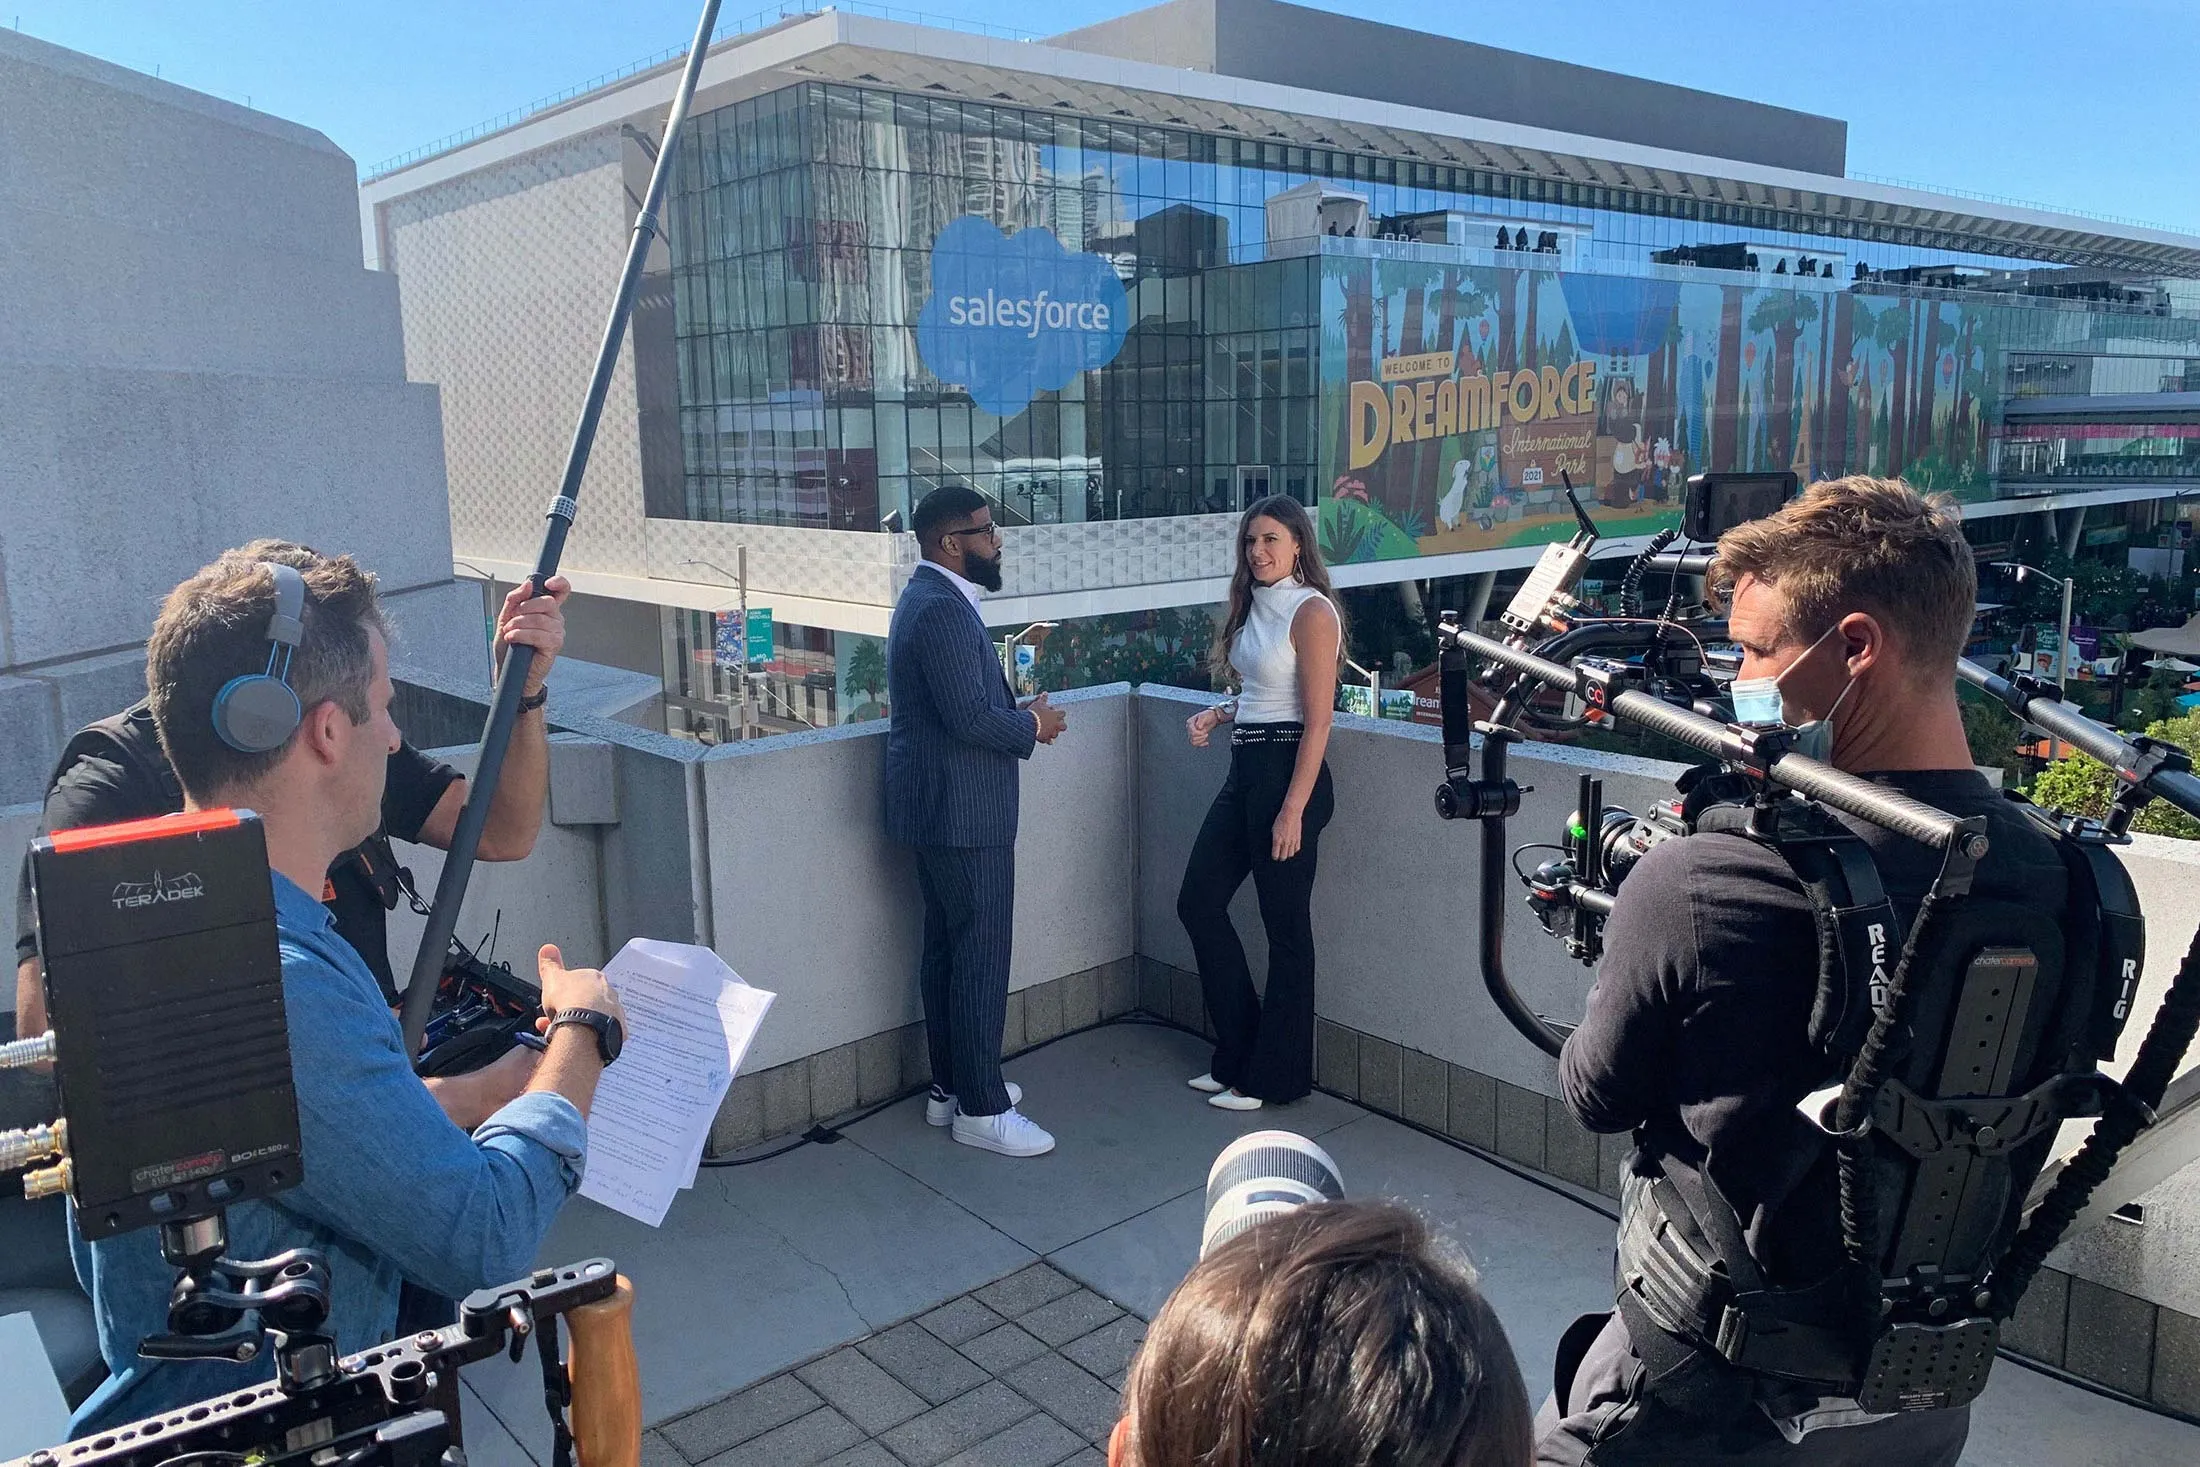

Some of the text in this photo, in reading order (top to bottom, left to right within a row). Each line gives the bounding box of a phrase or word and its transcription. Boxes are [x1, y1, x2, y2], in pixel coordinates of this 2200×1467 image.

[949, 289, 1110, 338] salesforce
[1385, 357, 1450, 375] WELCOME TO
[1349, 360, 1598, 470] DREAMFORCE
[1503, 427, 1592, 458] International
[1524, 470, 1542, 481] 2021
[1551, 453, 1587, 477] Park
[1587, 686, 1602, 704] CC
[112, 886, 205, 909] TERADEK
[2113, 958, 2136, 1019] RIG
